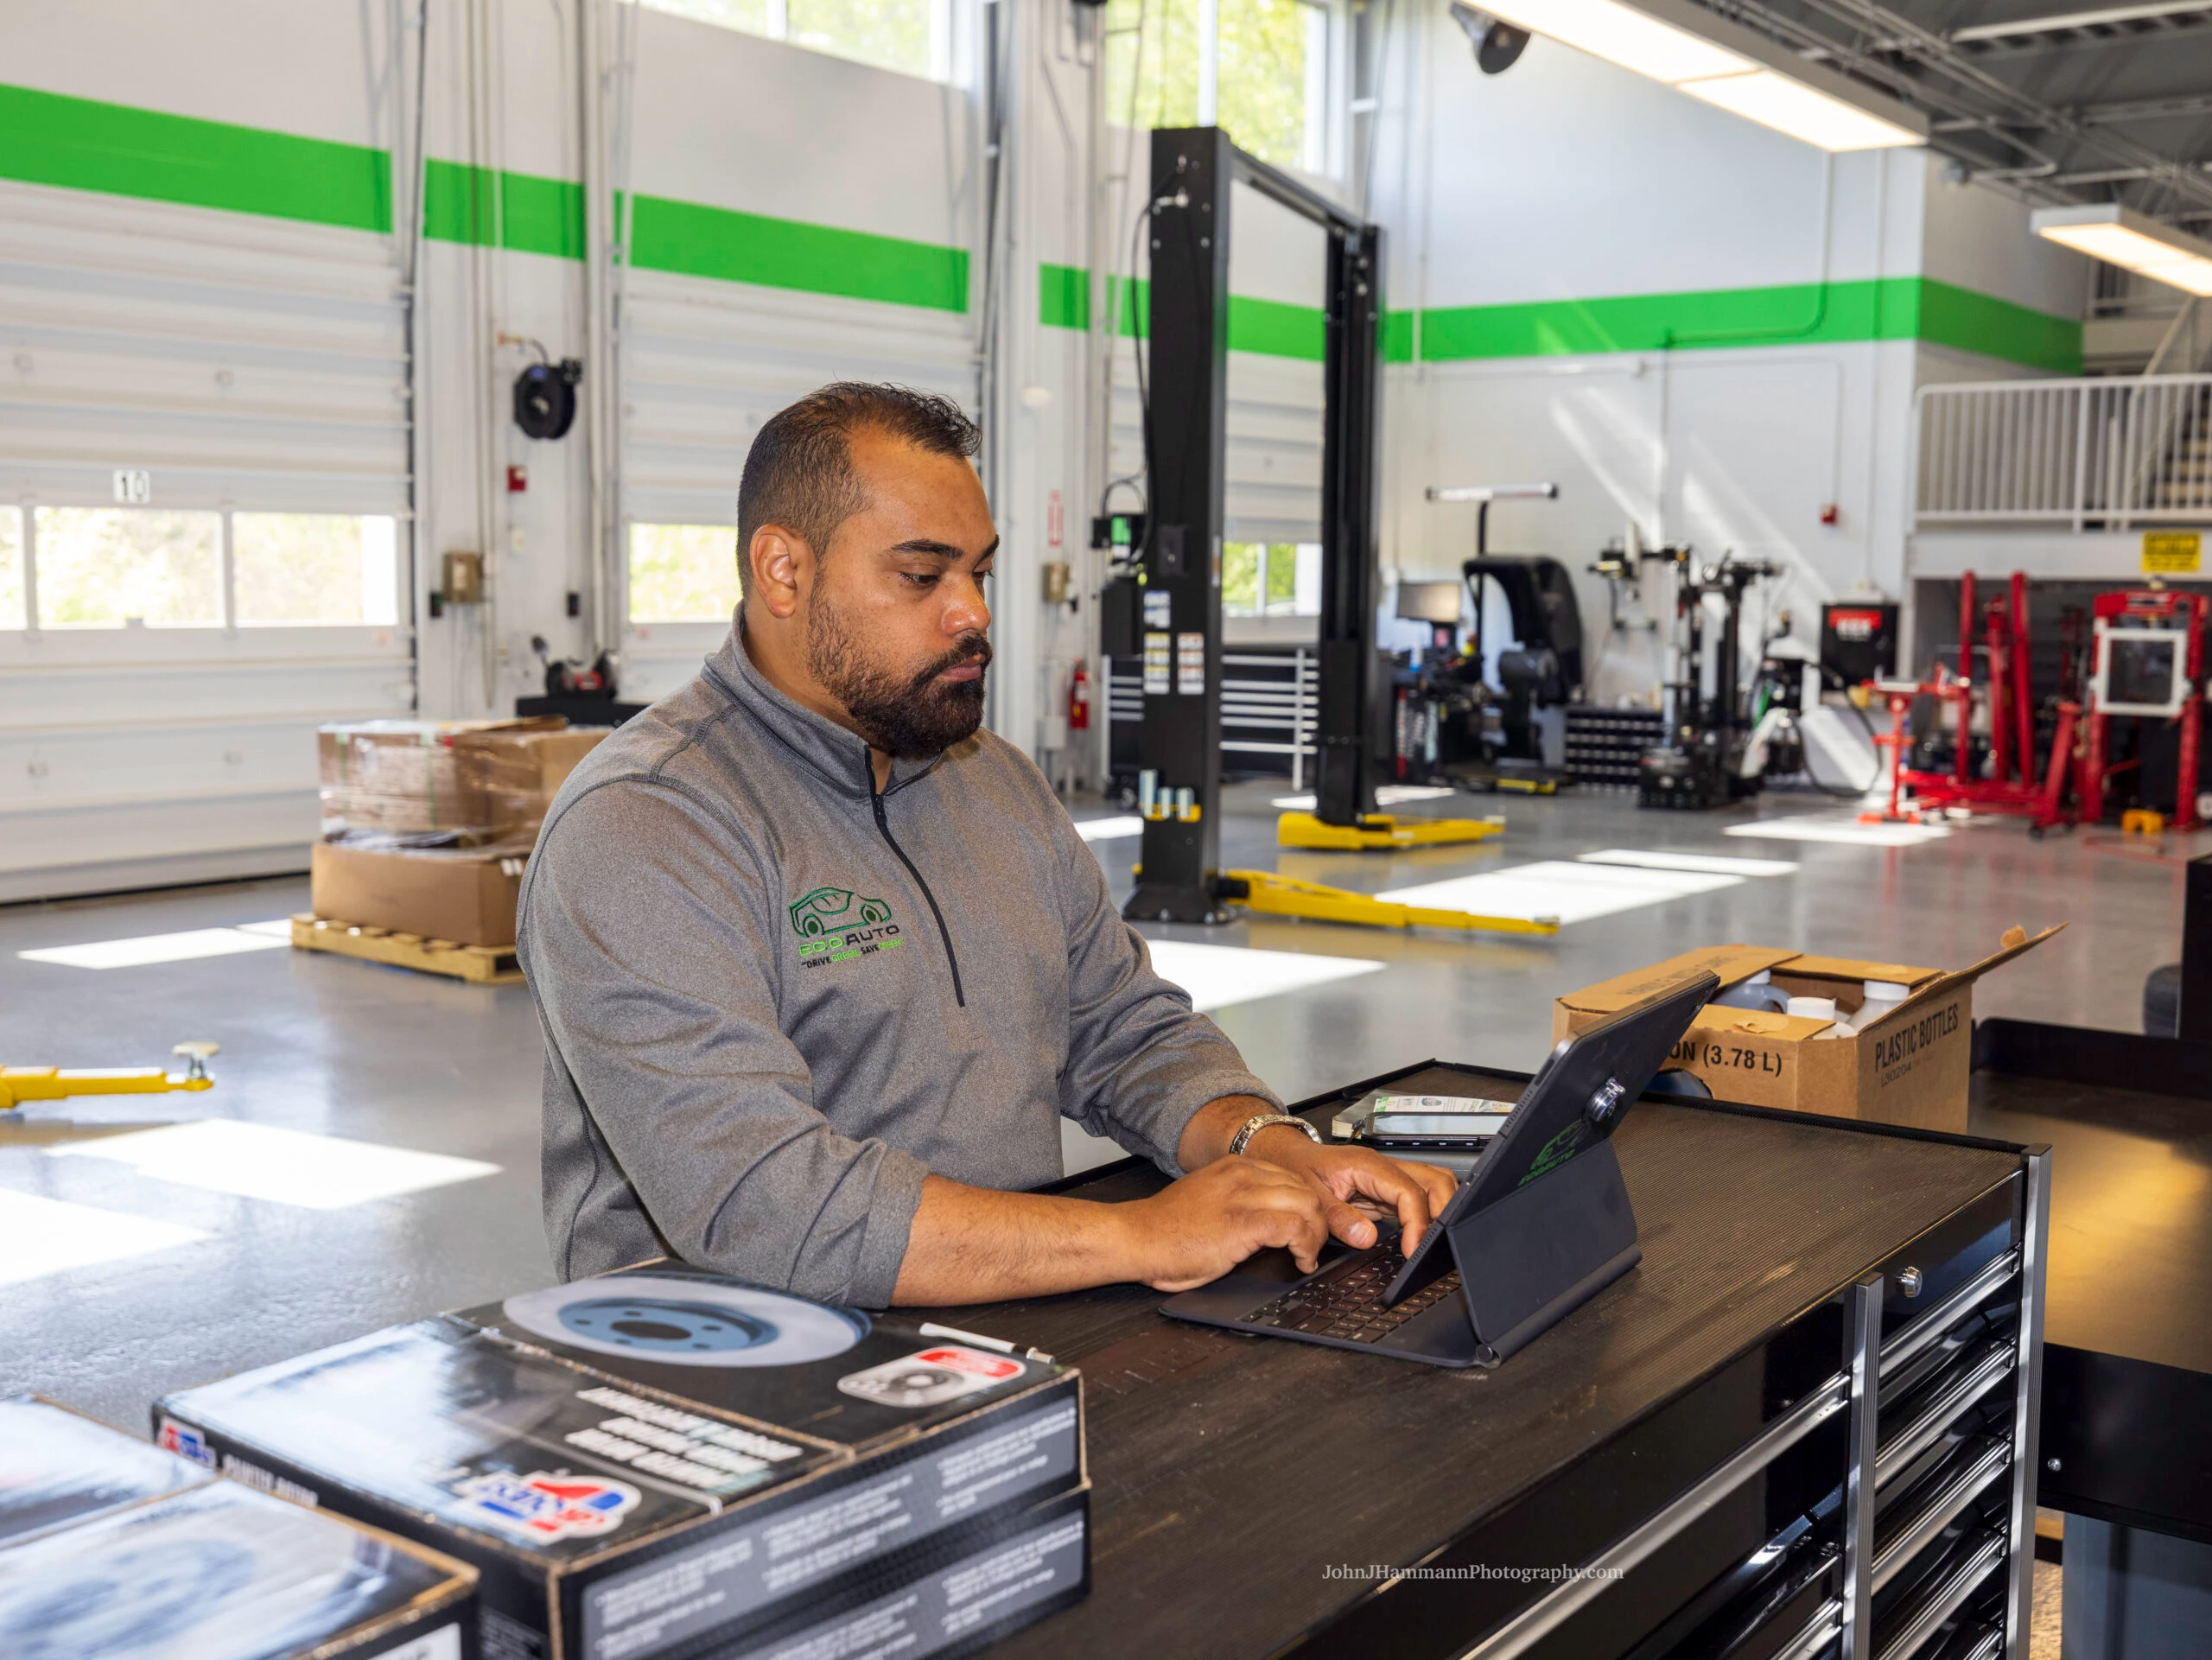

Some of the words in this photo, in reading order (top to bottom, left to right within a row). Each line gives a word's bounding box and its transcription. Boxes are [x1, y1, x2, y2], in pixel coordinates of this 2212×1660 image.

[861, 944, 880, 955] SAVE
[1875, 1024, 1917, 1072] PLASTIC
[1919, 1002, 1959, 1049] BOTTLES
[1703, 1043, 1756, 1070] (3.78
[1763, 1052, 1783, 1078] L)
